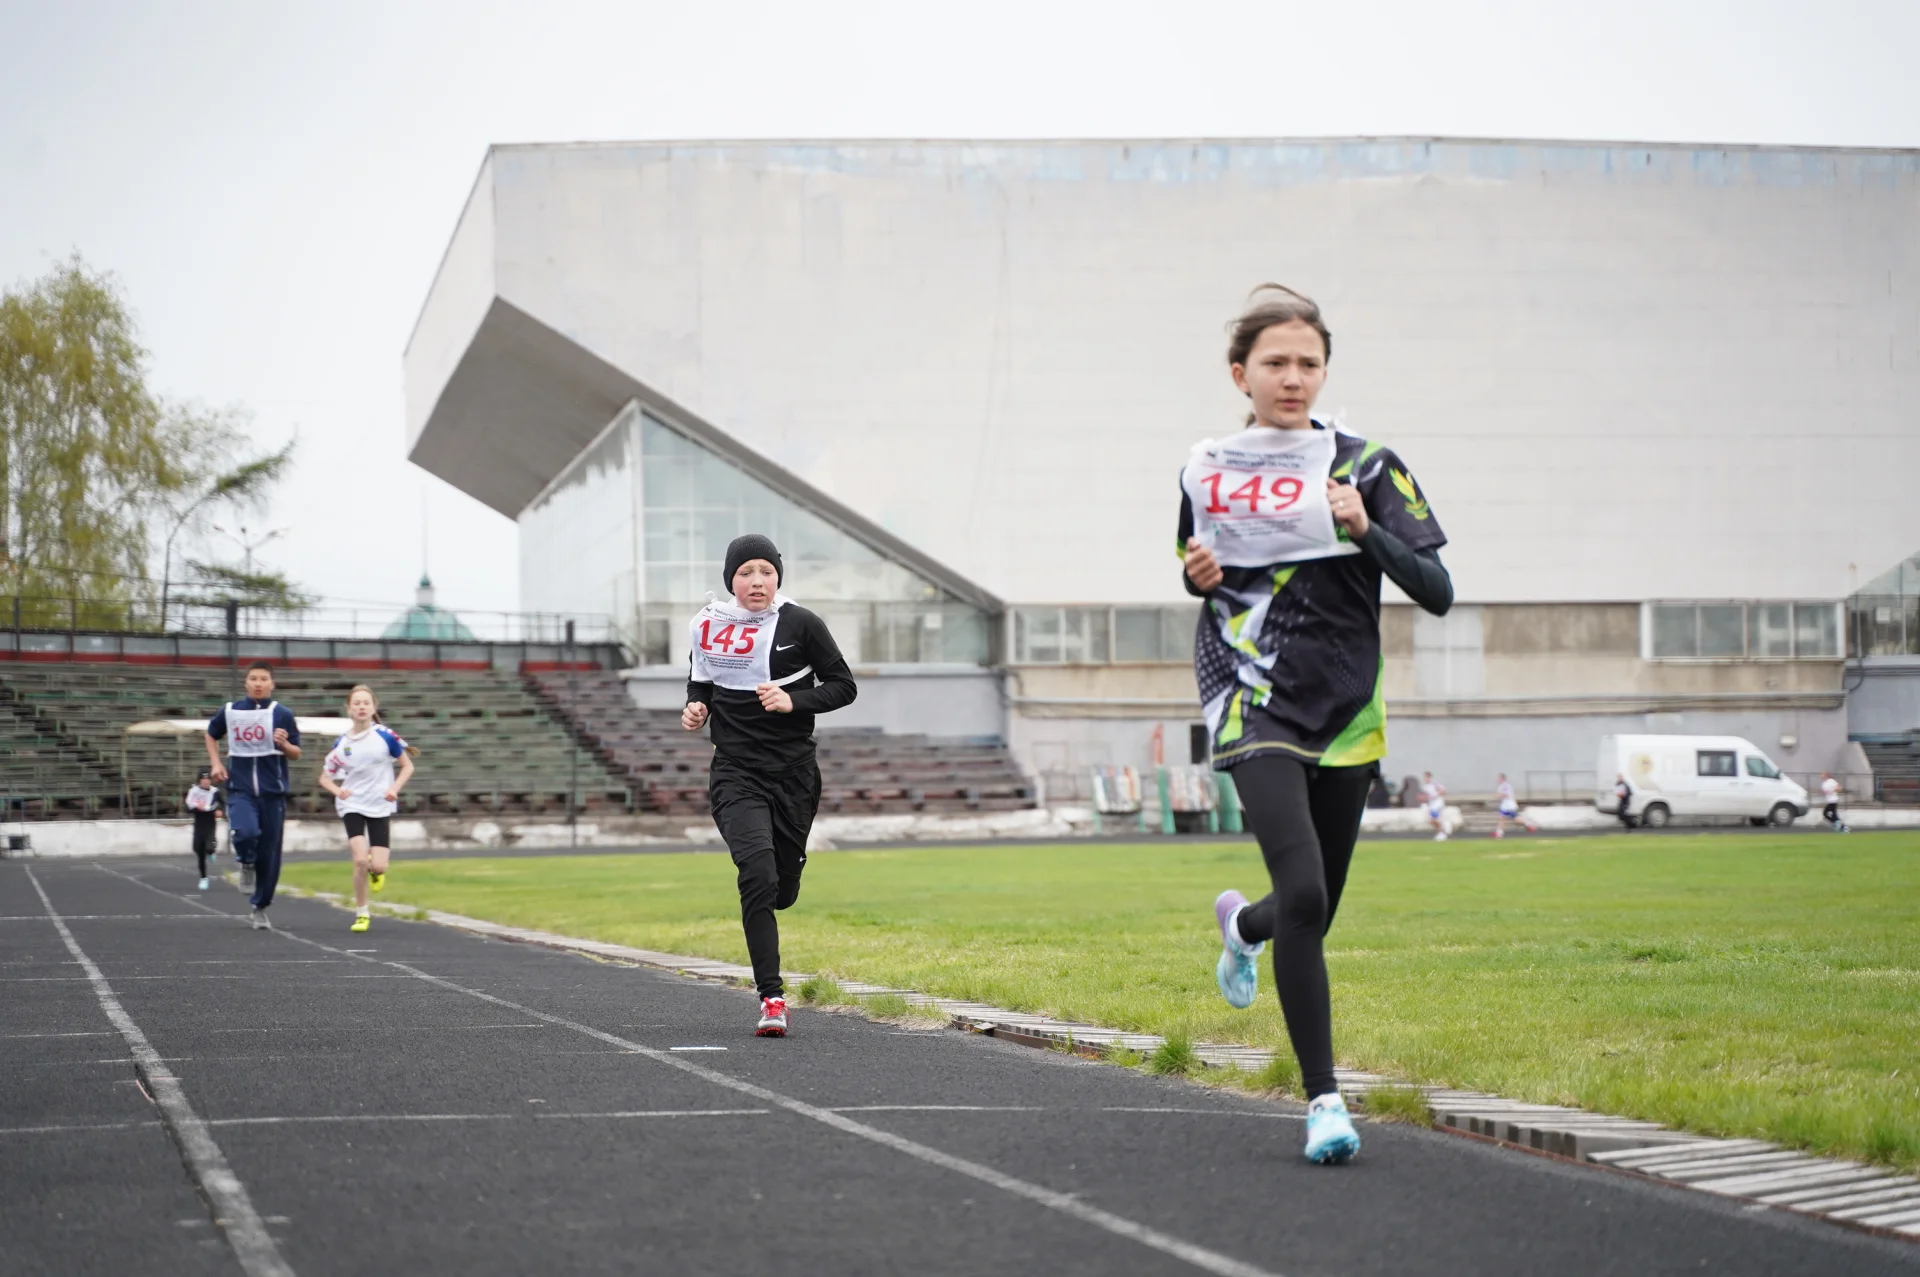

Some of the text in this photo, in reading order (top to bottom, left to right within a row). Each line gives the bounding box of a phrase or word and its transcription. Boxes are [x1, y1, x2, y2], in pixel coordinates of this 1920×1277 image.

[1200, 472, 1304, 514] 149
[699, 619, 759, 654] 145
[233, 725, 265, 741] 160
